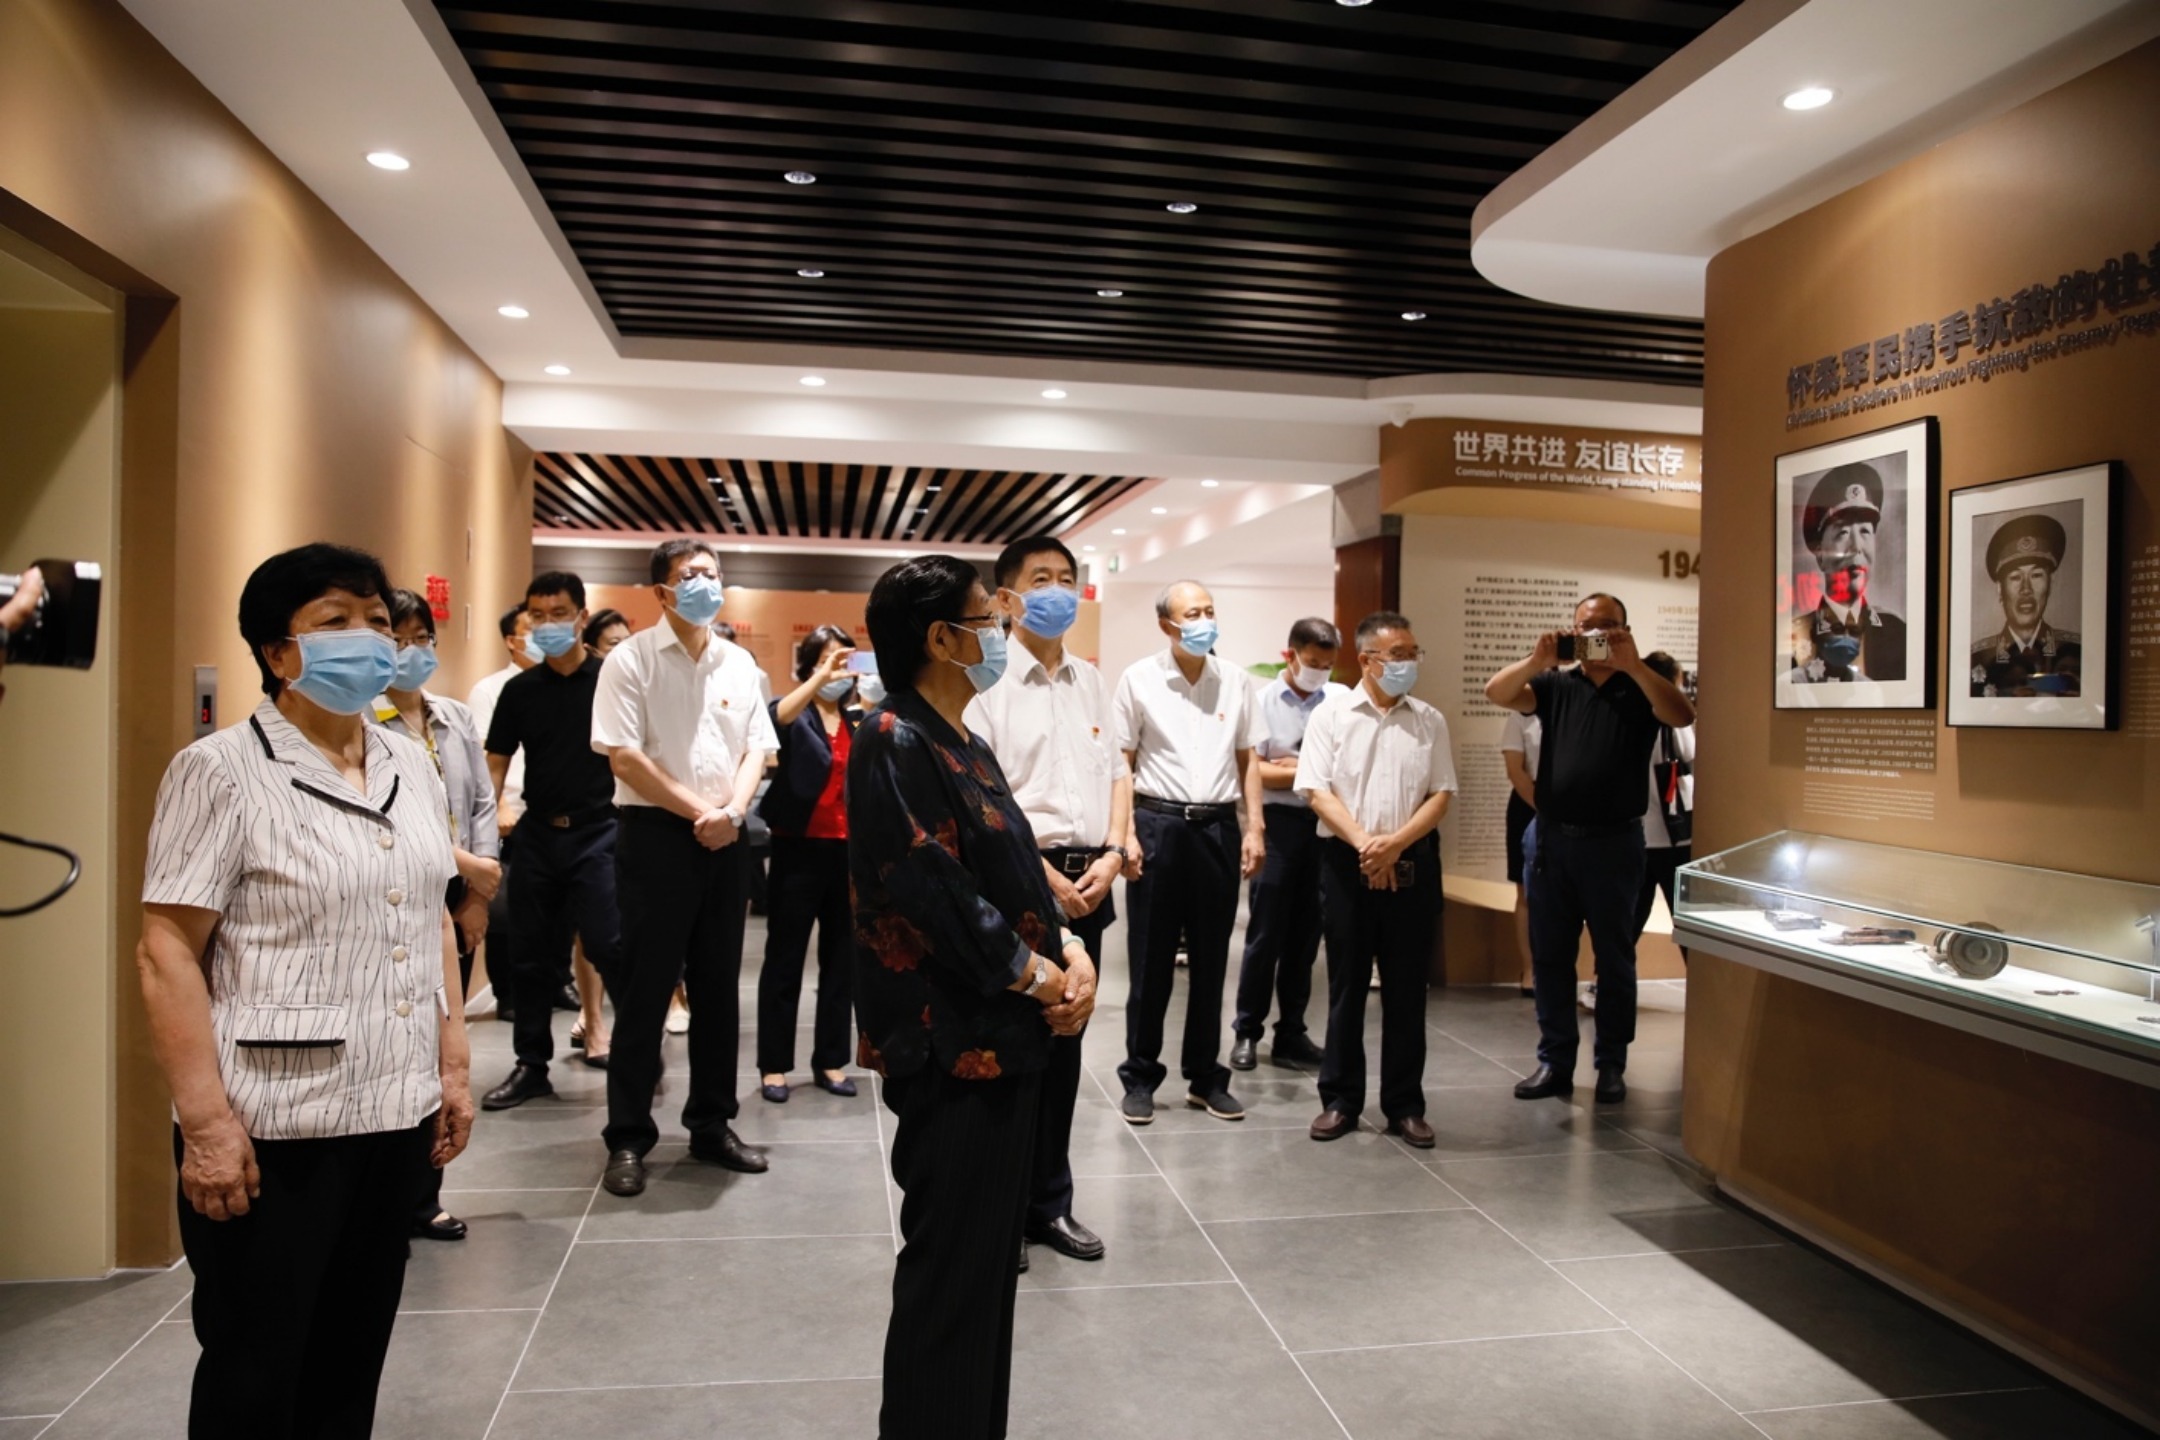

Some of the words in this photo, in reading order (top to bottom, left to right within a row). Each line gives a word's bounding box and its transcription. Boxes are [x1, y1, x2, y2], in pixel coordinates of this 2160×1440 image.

[1913, 366, 1966, 397] Huairou
[1967, 350, 2029, 381] Fighting
[2029, 340, 2056, 363] the
[2057, 321, 2116, 353] Enemy
[1453, 431, 1566, 468] 世界共进
[1575, 438, 1685, 477] 友谊长存
[1455, 466, 1498, 478] Common
[1499, 468, 1537, 482] Progress
[1539, 471, 1549, 482] of
[1549, 472, 1564, 482] the
[1566, 473, 1596, 486] World,
